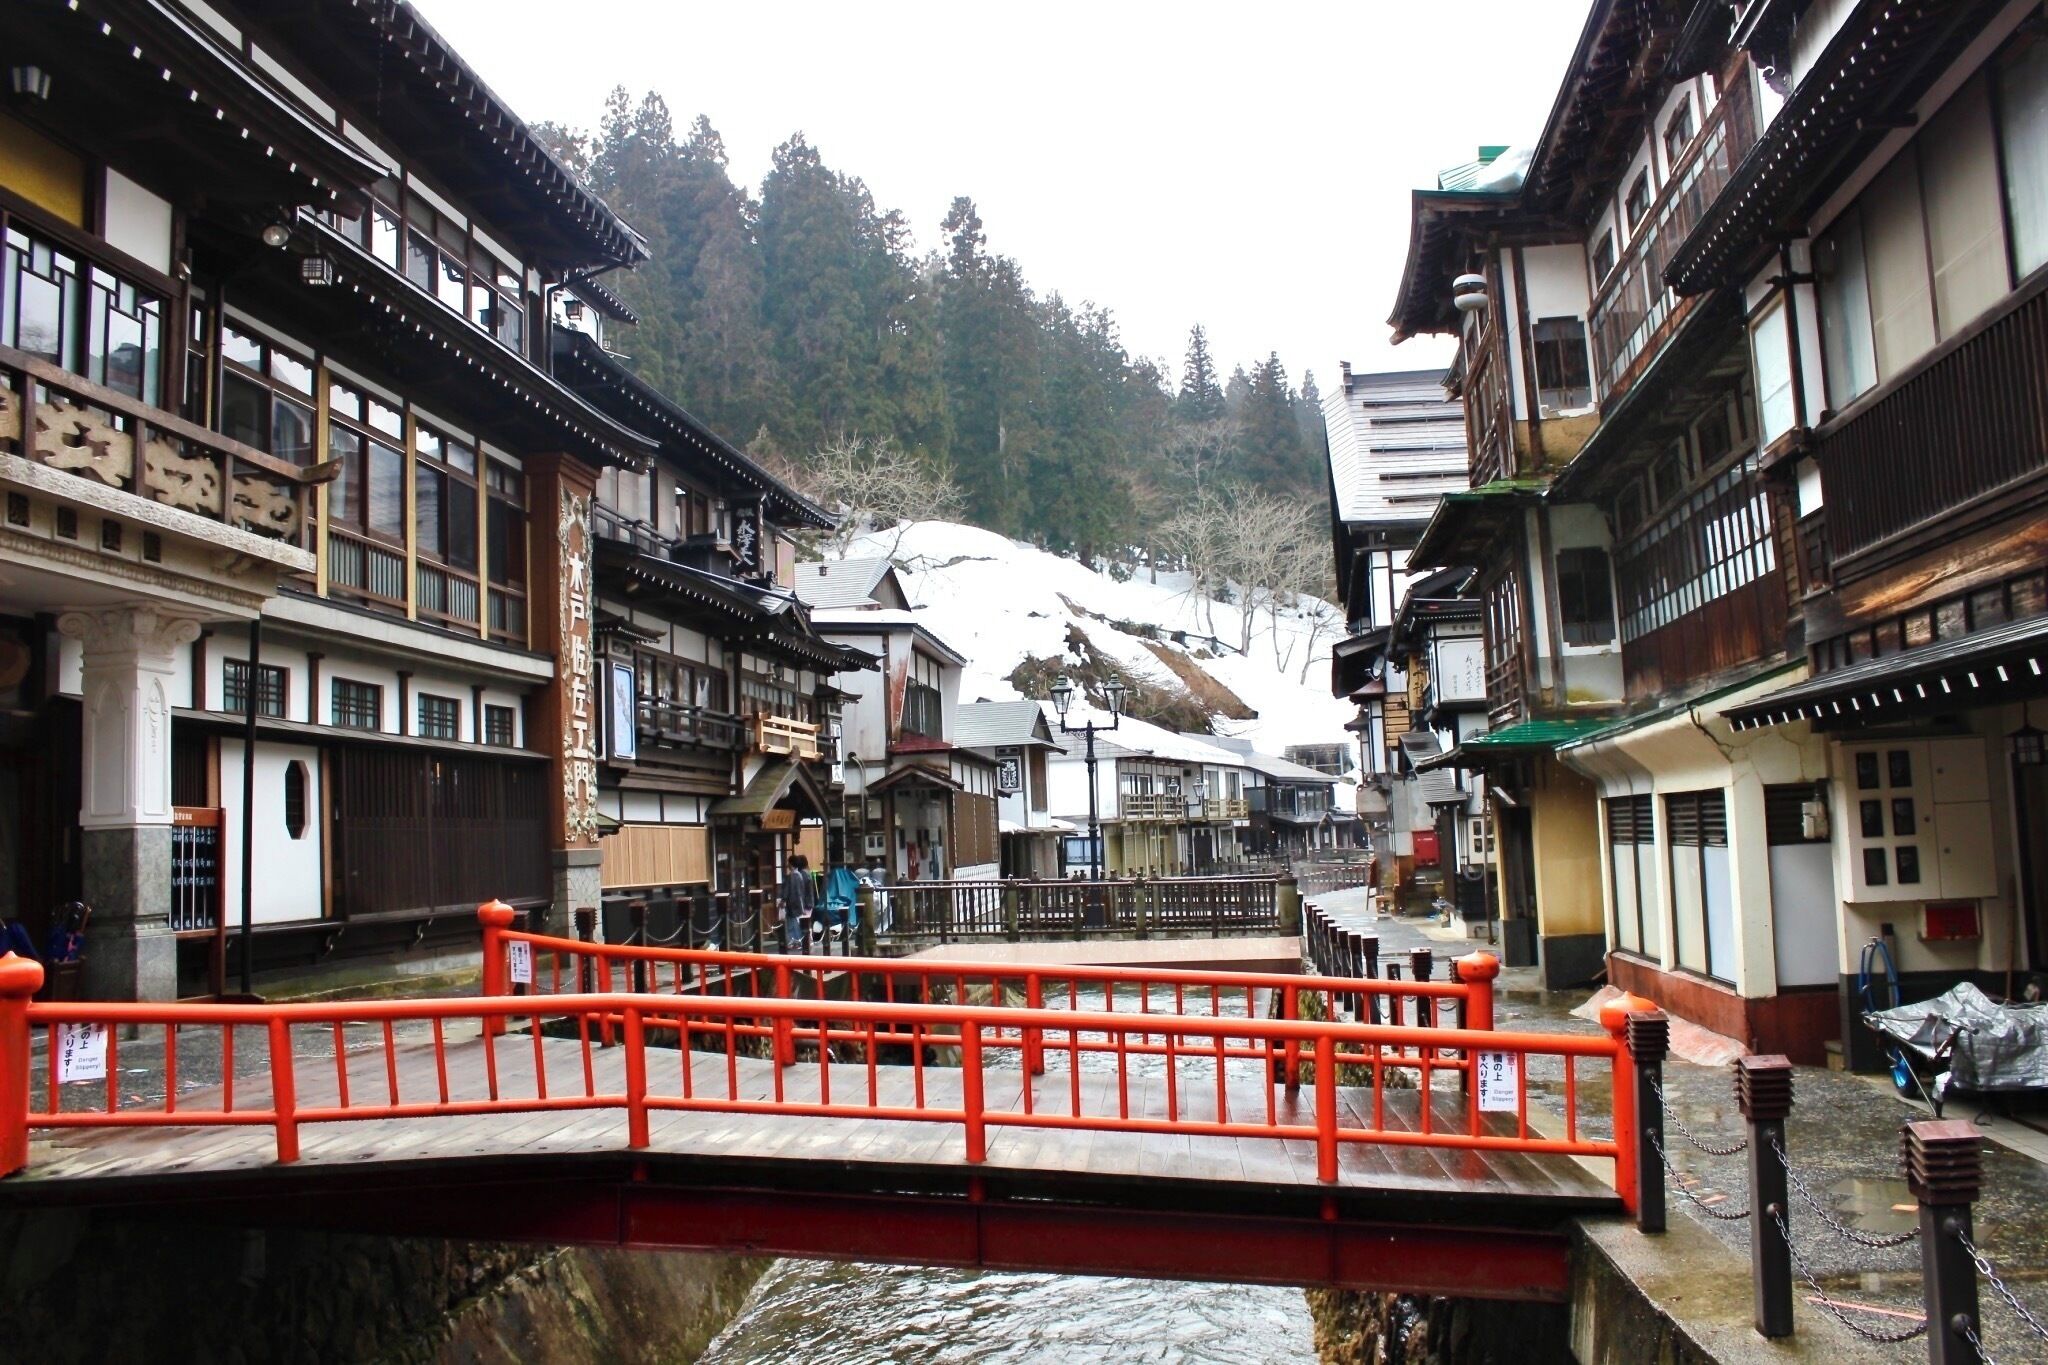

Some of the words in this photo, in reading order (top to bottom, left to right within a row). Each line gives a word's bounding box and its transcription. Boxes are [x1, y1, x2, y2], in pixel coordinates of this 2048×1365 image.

[1480, 1053, 1489, 1108] すべります！
